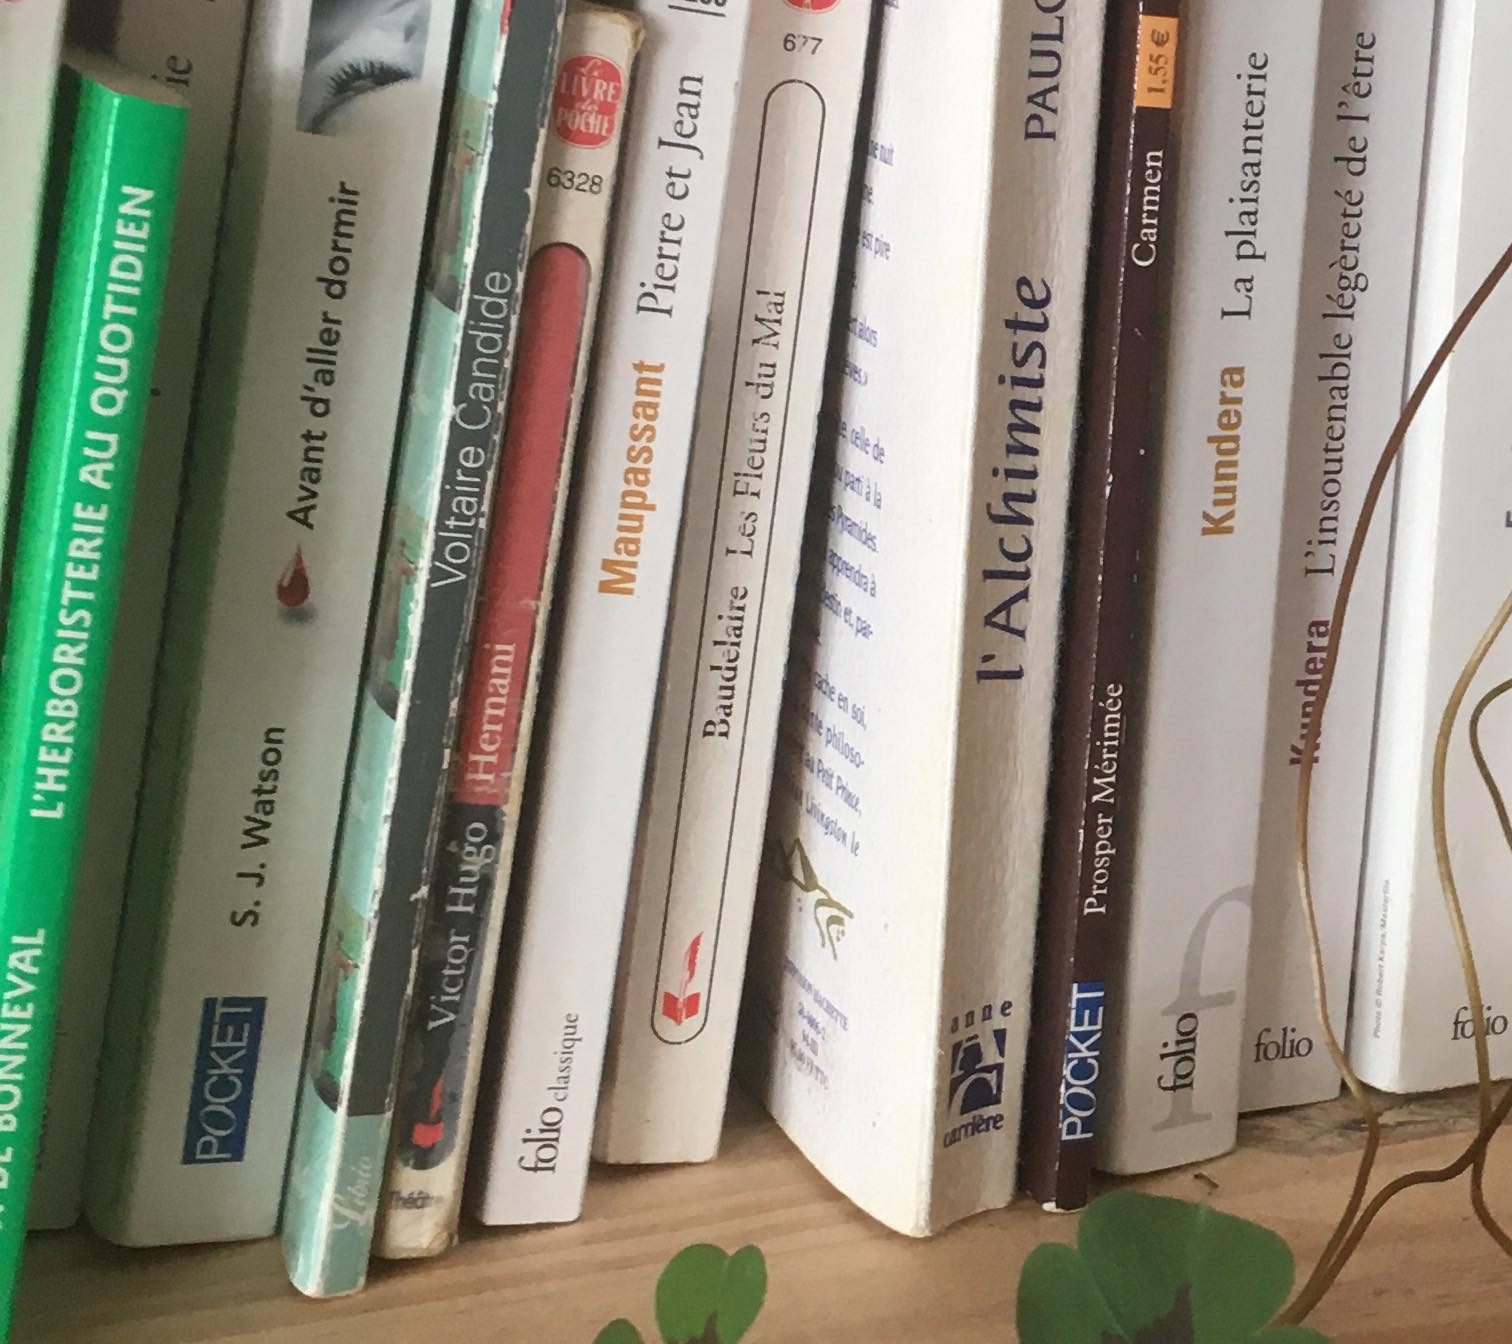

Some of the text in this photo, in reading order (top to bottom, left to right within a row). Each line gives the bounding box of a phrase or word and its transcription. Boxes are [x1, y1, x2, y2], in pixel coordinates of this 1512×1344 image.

[560, 71, 622, 103] LIVRE
[1336, 31, 1378, 123] l'être
[1338, 135, 1369, 178] de
[546, 167, 604, 195] 6328
[1323, 188, 1369, 321] légèreté
[285, 180, 361, 531] Avant d'aller dormir
[597, 75, 705, 597] Maupassant Pierre et Jean
[1201, 51, 1270, 537] Kundera La plaisanterie
[29, 184, 155, 820] L'HERBORISTERIE AU QUOTIDIEN
[430, 269, 513, 589] Voltaire Candide
[975, 275, 1052, 684] l'Alchimiste
[1304, 331, 1355, 577] L'insoutenable
[702, 289, 787, 740] Baudelaire Les Fleurs du Mal
[1083, 149, 1164, 916] Prosper Mérimée Carmen
[465, 641, 517, 790] Hernani
[231, 725, 286, 928] S. J. Watson
[427, 819, 497, 1032] Victor Hugo
[194, 998, 256, 1163] POCKET
[519, 1011, 588, 1175] folio classique
[950, 999, 1014, 1035] anne
[1060, 983, 1105, 1142] POCKET
[1157, 1012, 1200, 1096] folio
[1252, 1026, 1314, 1064] folio
[1450, 1004, 1509, 1042] foio
